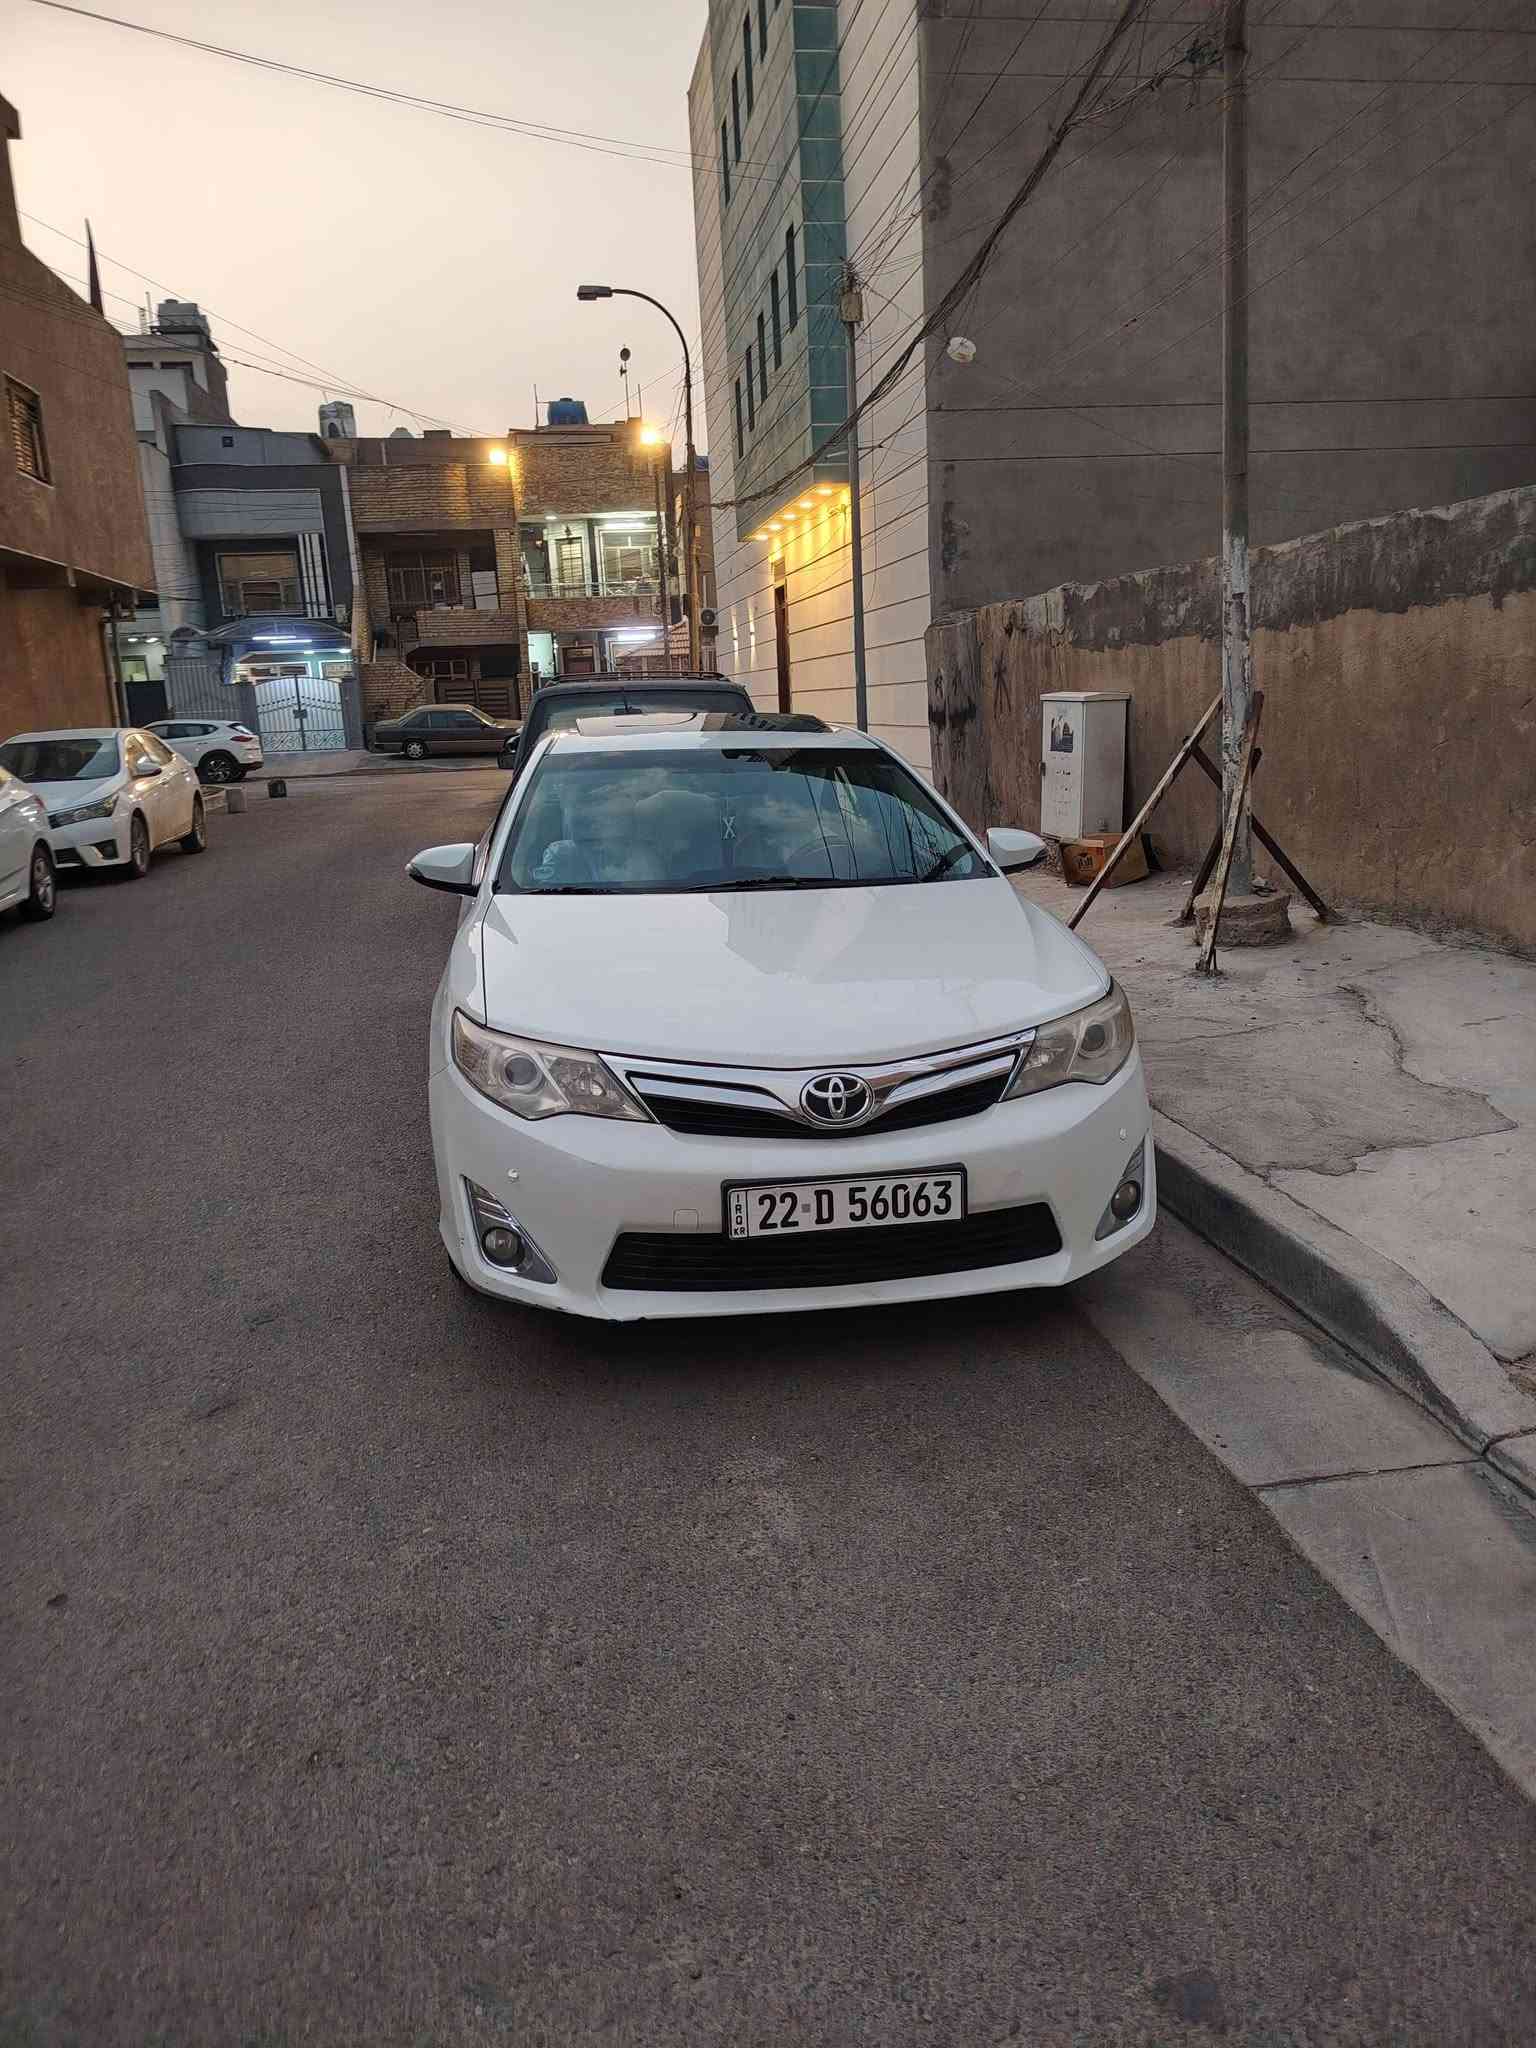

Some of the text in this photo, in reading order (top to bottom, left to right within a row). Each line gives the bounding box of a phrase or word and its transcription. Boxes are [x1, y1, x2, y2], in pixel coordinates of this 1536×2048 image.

[758, 1180, 952, 1230] 22 D 56063
